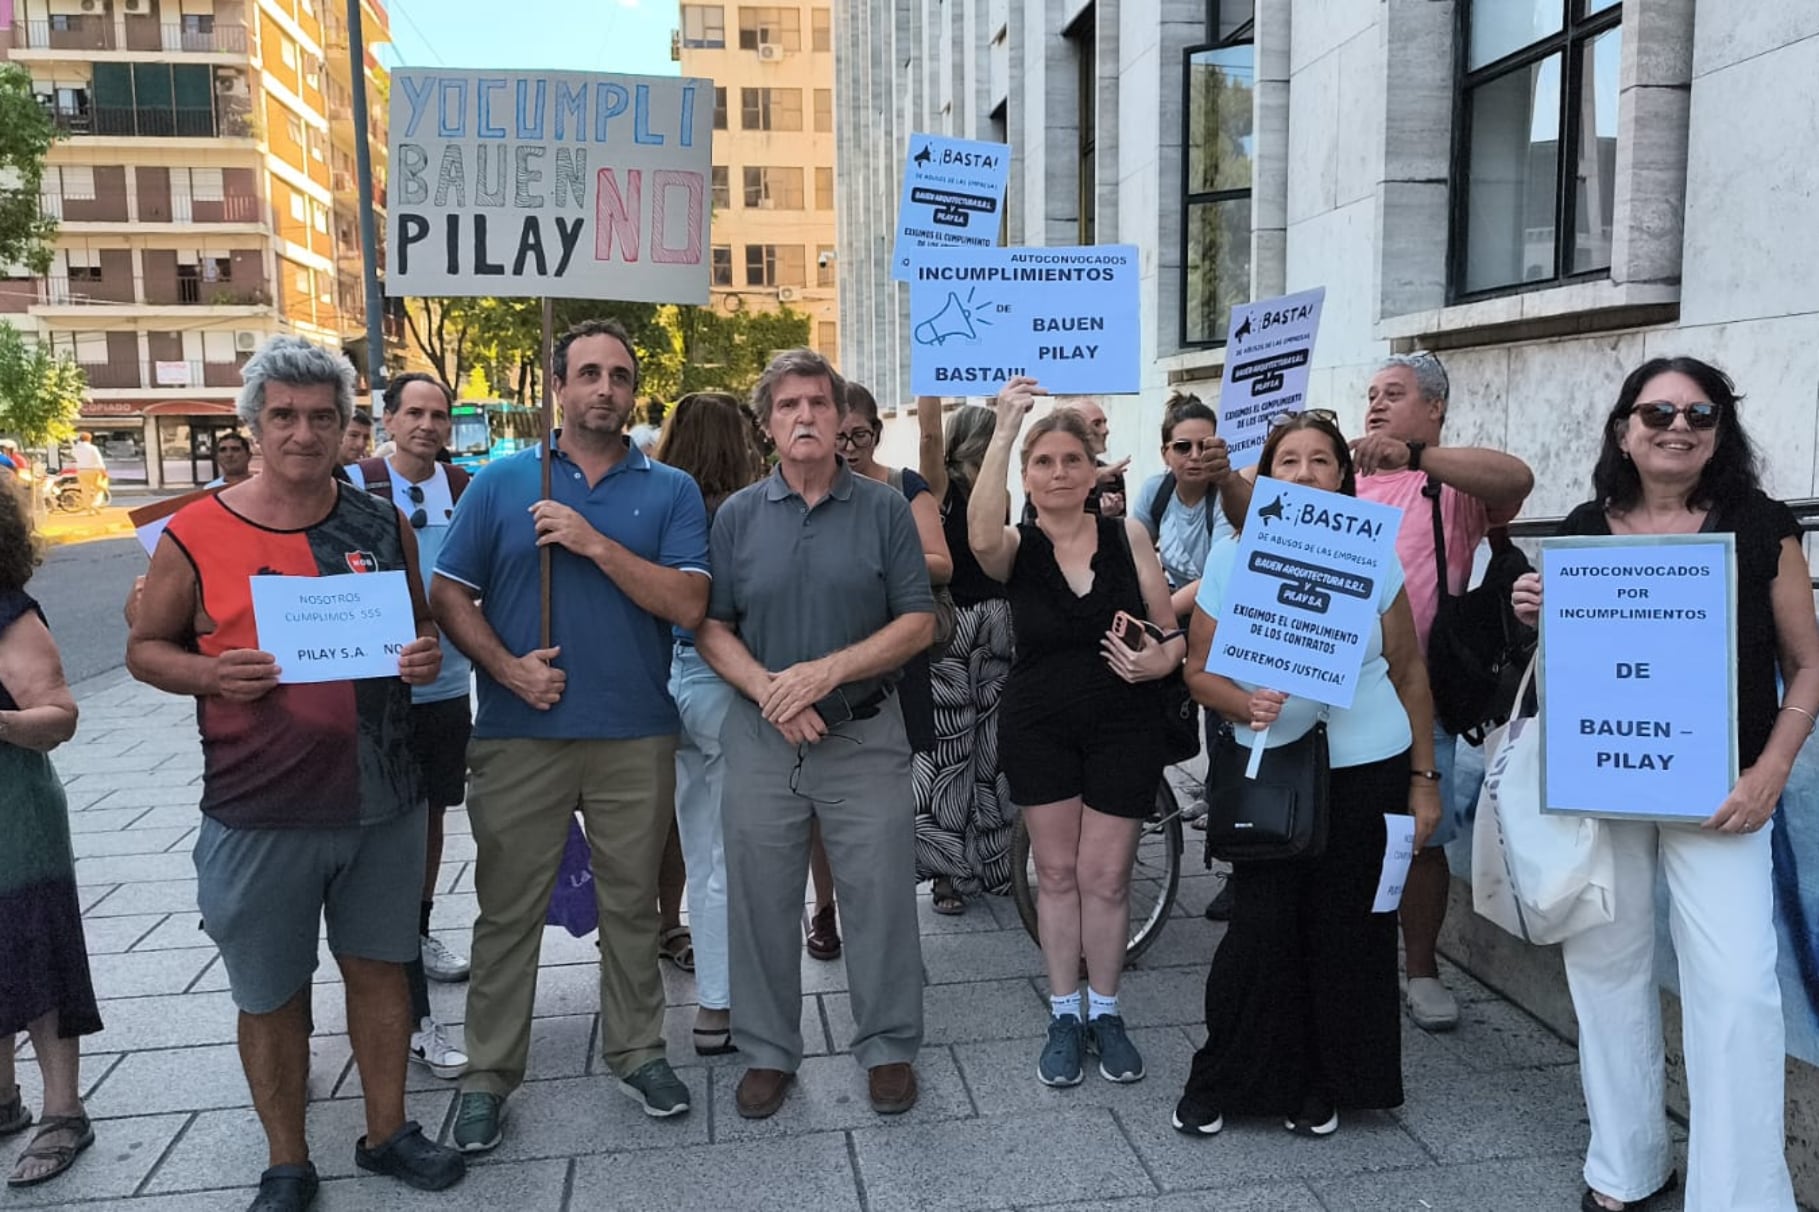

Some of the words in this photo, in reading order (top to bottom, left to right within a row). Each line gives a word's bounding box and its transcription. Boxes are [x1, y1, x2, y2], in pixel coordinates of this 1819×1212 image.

[399, 143, 588, 209] BAUEN
[595, 167, 704, 265] NO
[397, 213, 585, 277] PILAY
[1011, 253, 1127, 265] AUTOCONVOCADOS
[918, 267, 1114, 282] INCUMPLIMIENTOS
[996, 304, 1012, 314] DE
[1032, 317, 1105, 332] BAUEN
[1039, 345, 1099, 360] PILAY
[1294, 503, 1383, 542] ¡BASTA!
[1257, 531, 1268, 541] DE
[1270, 535, 1302, 550] ABUSOS
[1304, 543, 1314, 553] DE
[1316, 546, 1332, 558] LAS
[1332, 550, 1377, 568] EMPRESAS
[1560, 565, 1710, 577] AUTOCONVOCADOS
[1304, 582, 1312, 591] Y
[1617, 588, 1649, 599] POR
[300, 592, 361, 605] NOSOTROS
[285, 611, 356, 622] CUMPLIMOS
[1560, 608, 1707, 620] INCUMPLIMIENTOS
[1233, 603, 1277, 624] EXIGIMOS
[1278, 614, 1288, 627] EL
[1290, 618, 1359, 645] CUMPLIMIENTO
[1250, 623, 1263, 636] DE
[1264, 626, 1282, 640] LOS
[1283, 631, 1336, 655] CONTRATOS
[297, 648, 337, 661] PILAY
[383, 643, 404, 655] NO
[1291, 662, 1345, 685] JUSTICIA!
[1616, 662, 1651, 679] DE
[1580, 718, 1671, 738] BAUEN
[1596, 751, 1675, 771] PILAY
